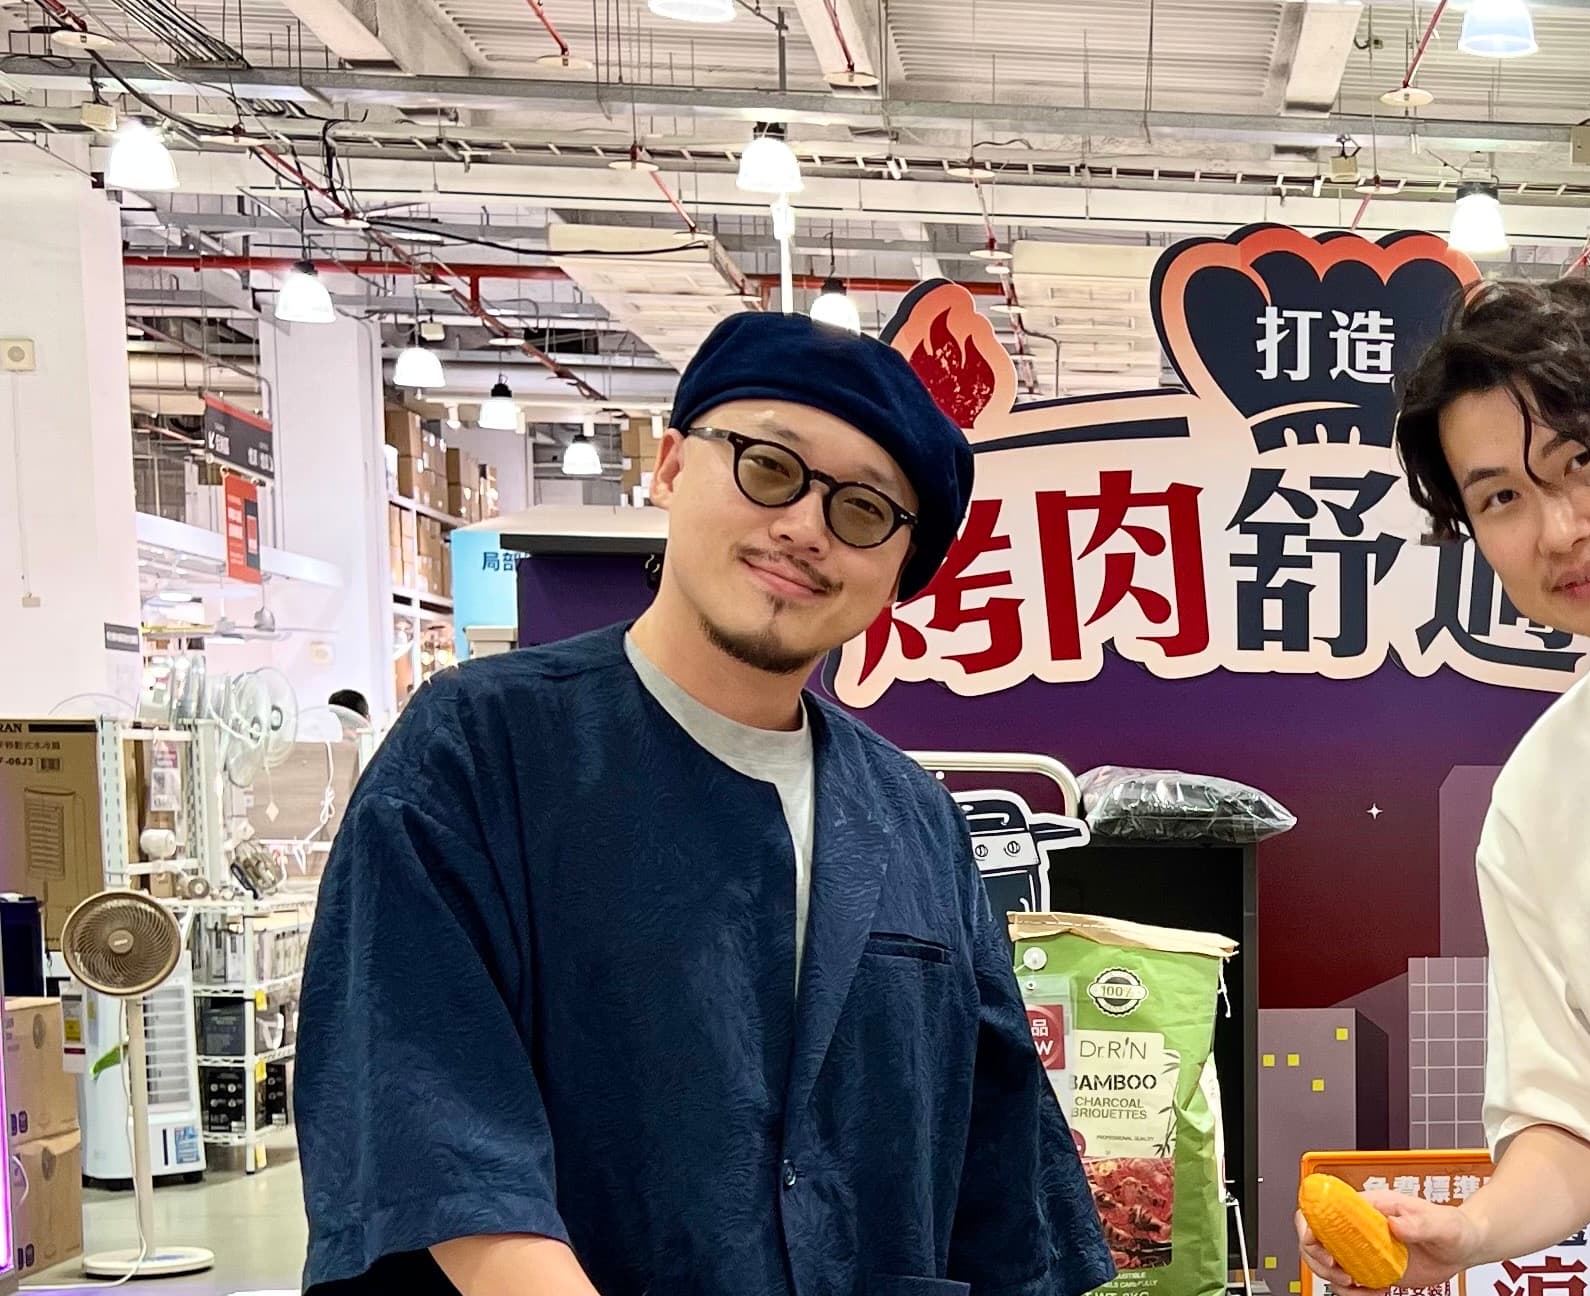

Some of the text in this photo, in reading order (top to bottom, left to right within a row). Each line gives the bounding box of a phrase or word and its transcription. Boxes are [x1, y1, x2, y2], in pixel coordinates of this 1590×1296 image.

[1256, 305, 1396, 385] 打造
[1031, 1019, 1049, 1037] 品
[1075, 1096, 1145, 1109] CHARCOAL
